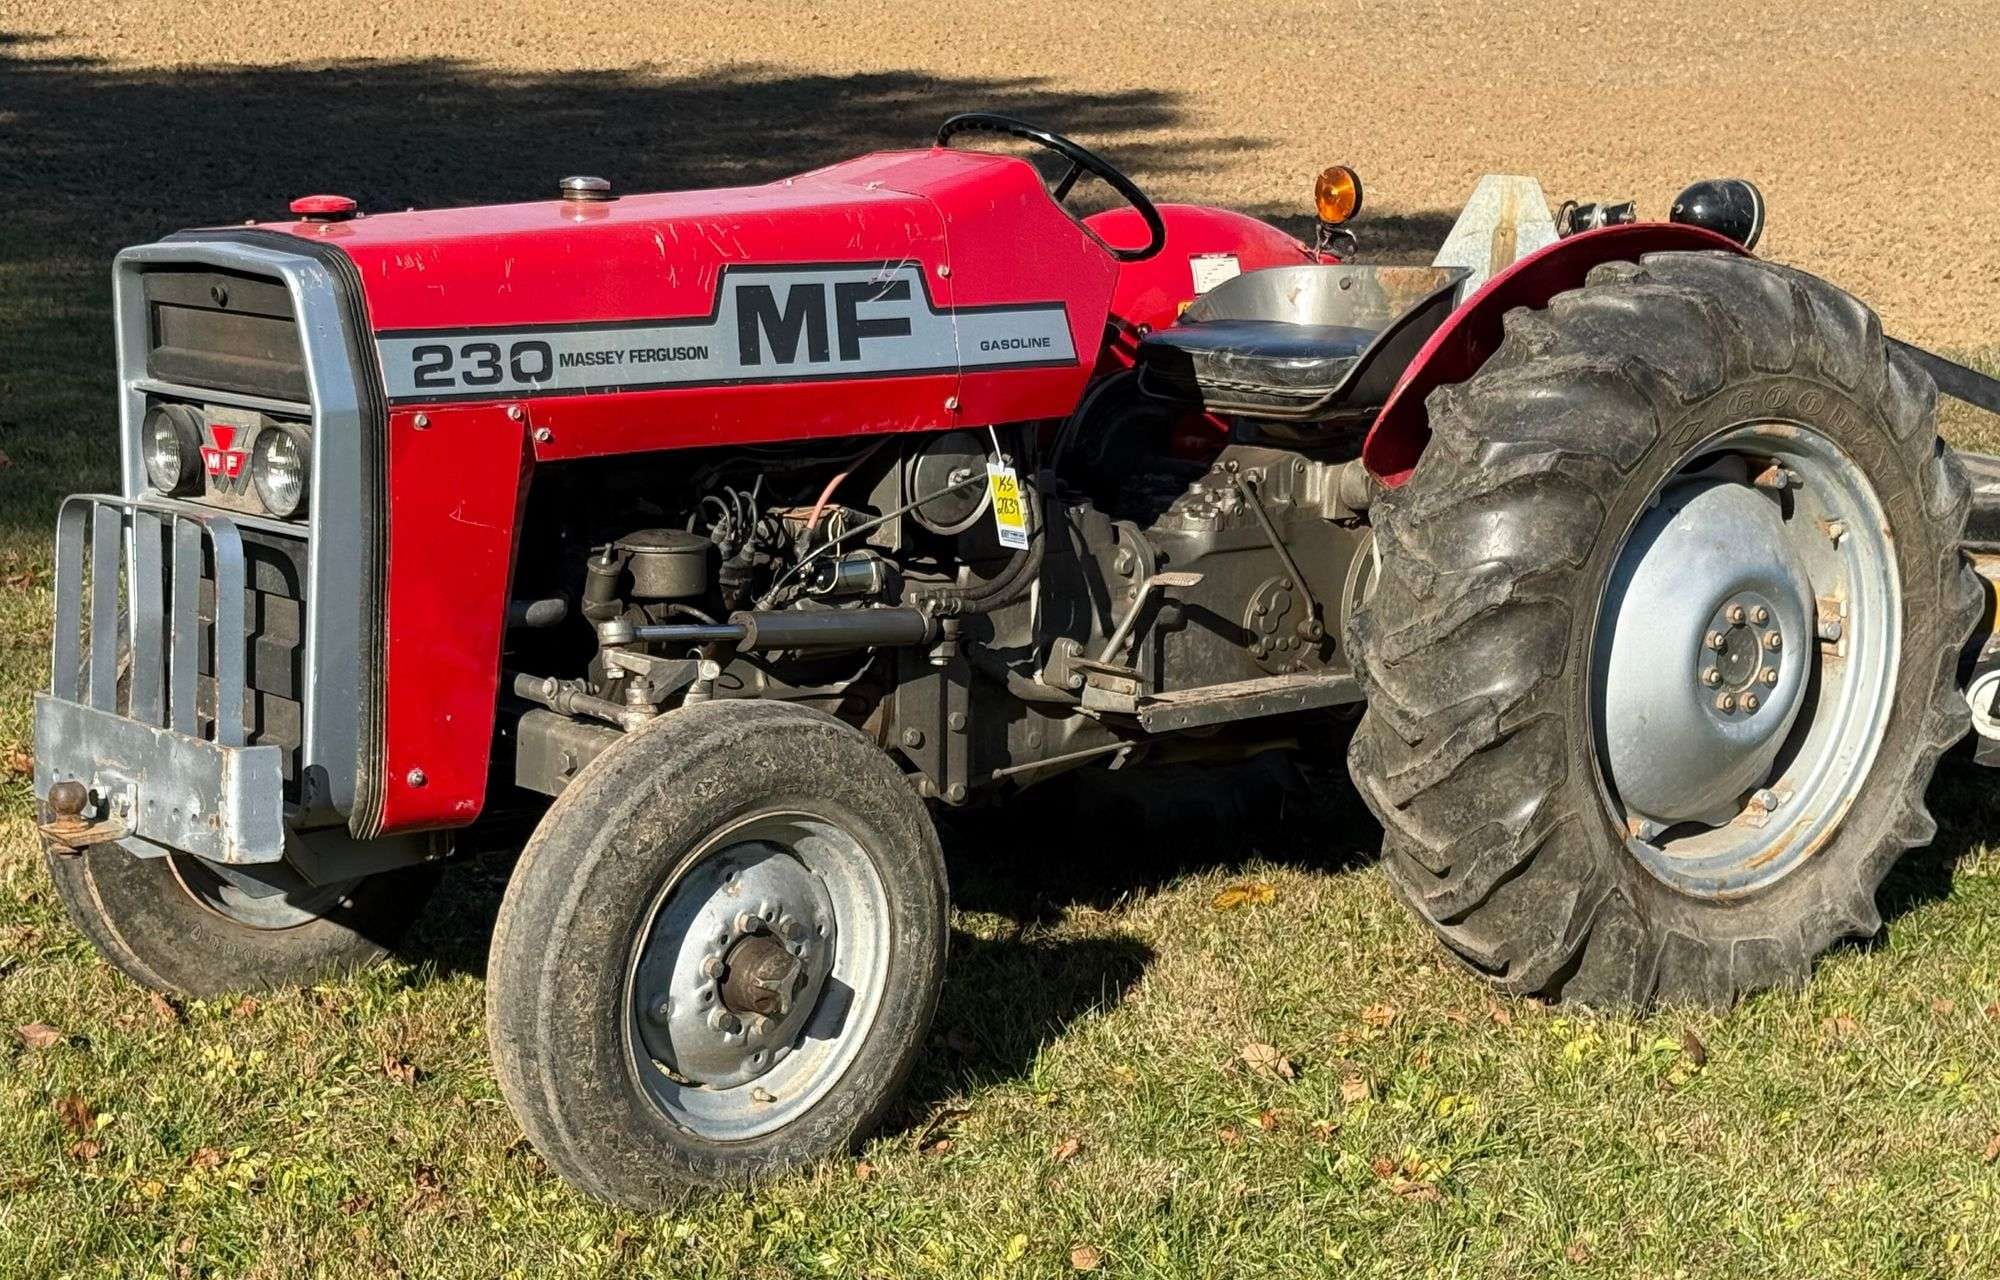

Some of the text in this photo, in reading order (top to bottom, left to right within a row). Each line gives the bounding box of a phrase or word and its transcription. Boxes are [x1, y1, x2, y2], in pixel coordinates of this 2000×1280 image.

[736, 280, 912, 366] MF
[980, 336, 1051, 352] GASOLINE
[412, 340, 709, 389] 230 MASSEY FERGUSON
